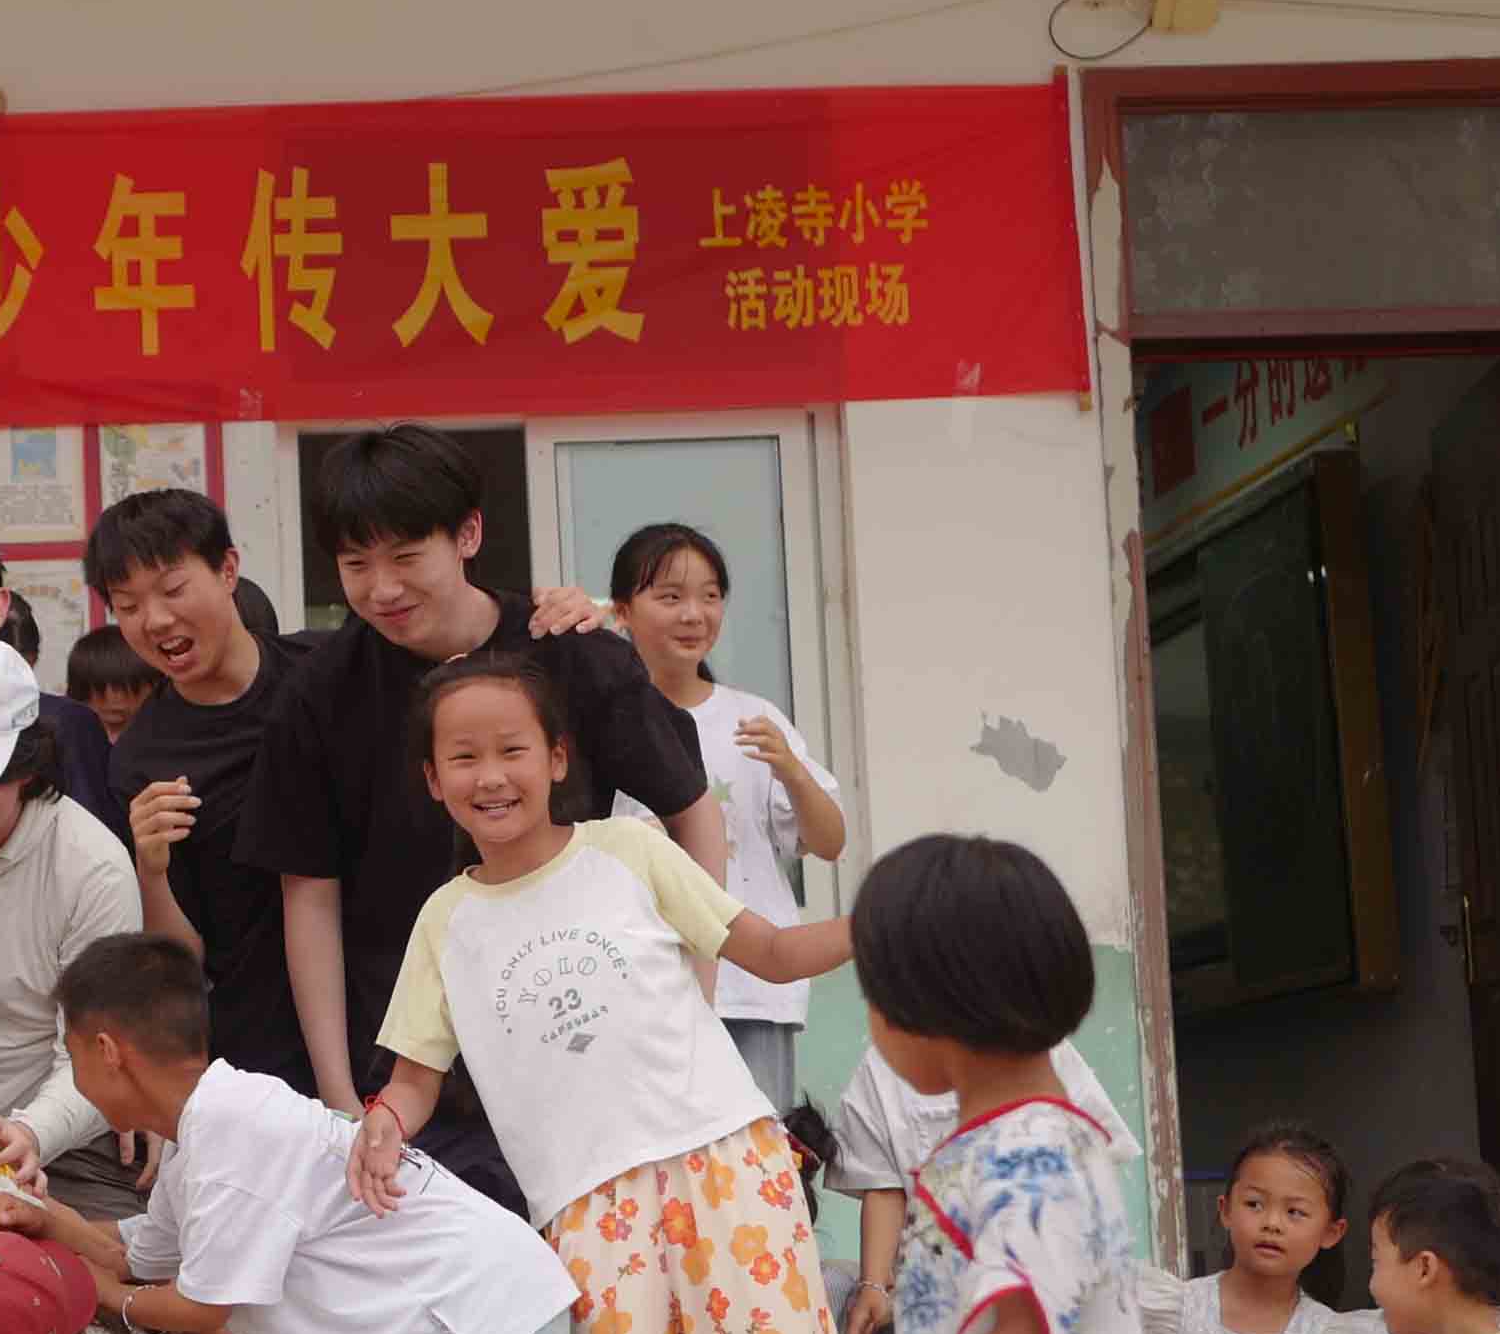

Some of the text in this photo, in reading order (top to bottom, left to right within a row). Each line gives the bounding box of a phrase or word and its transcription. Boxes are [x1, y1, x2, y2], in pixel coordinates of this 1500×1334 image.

[697, 177, 930, 249] 上凌寺小学
[723, 261, 912, 331] 活动现场
[496, 928, 627, 1024] YOU ONLY LIVE ONCE
[548, 987, 583, 1020] 23
